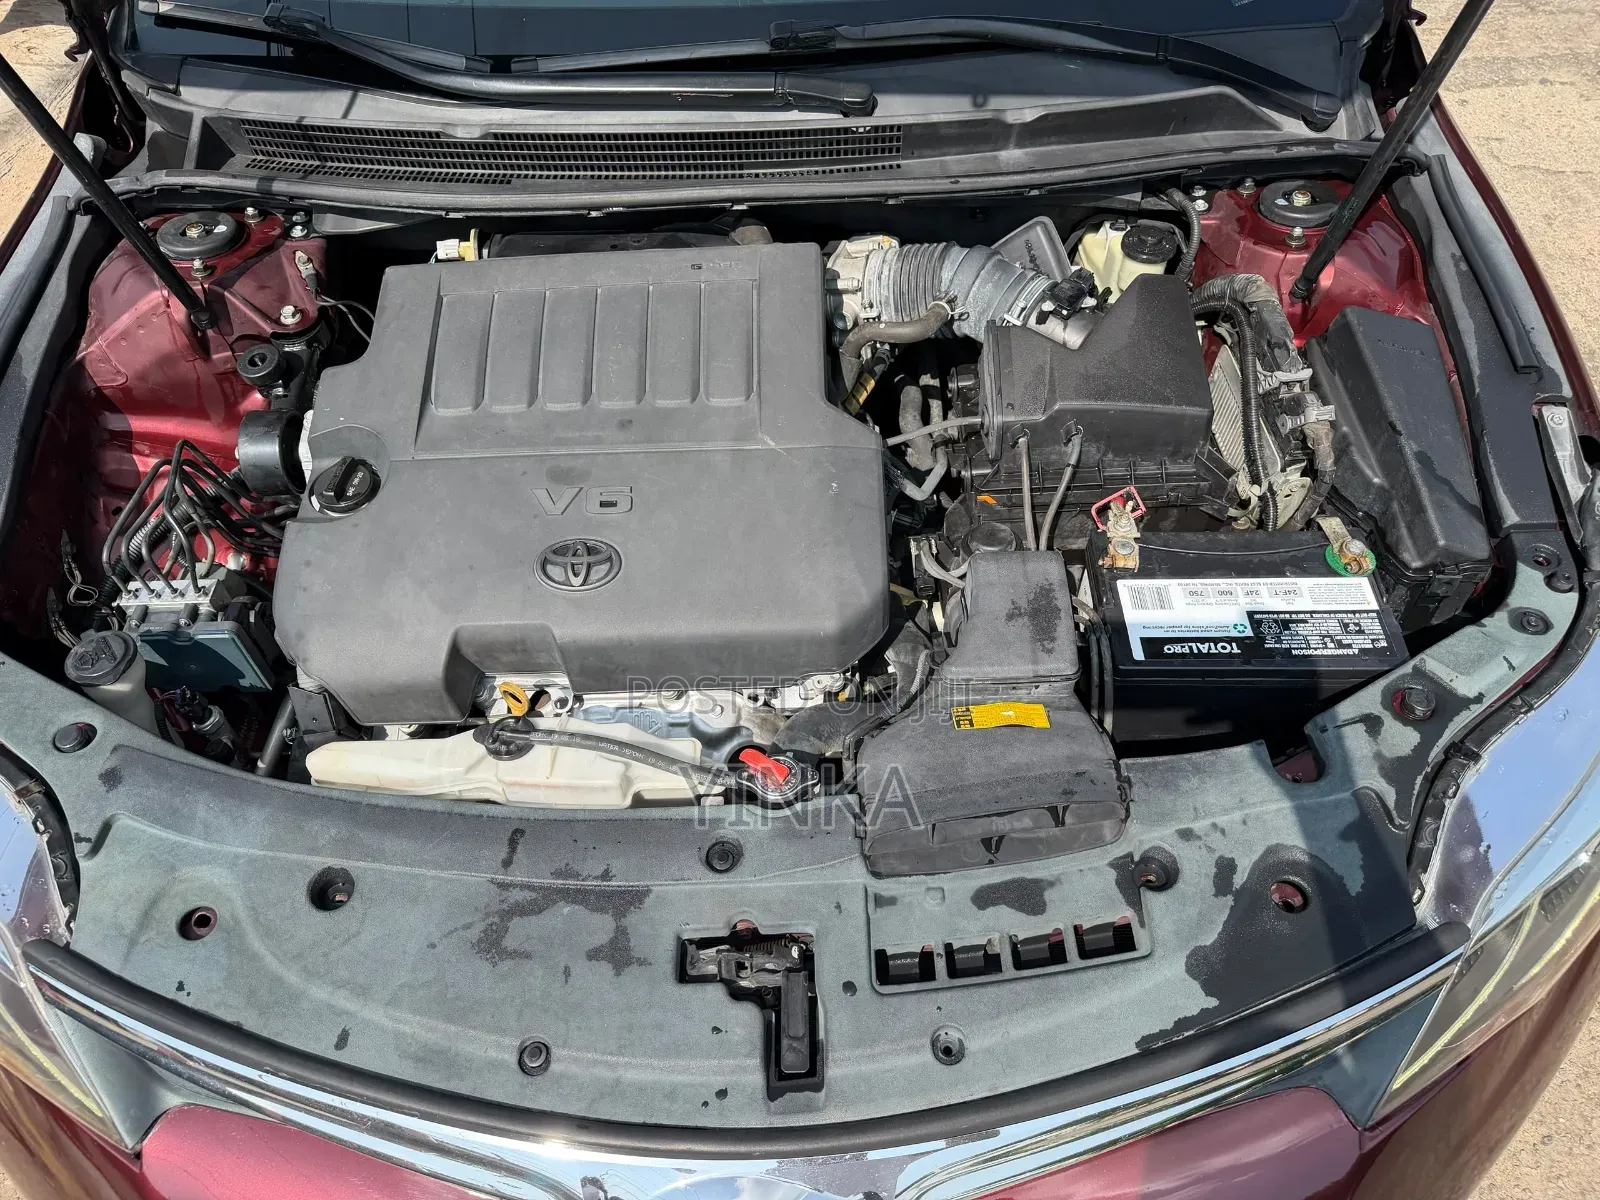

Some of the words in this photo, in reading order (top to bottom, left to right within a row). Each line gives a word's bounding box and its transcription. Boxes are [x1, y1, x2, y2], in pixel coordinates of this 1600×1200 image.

[347, 487, 356, 496] SAE
[530, 486, 634, 516] V6
[598, 741, 619, 751] WATER
